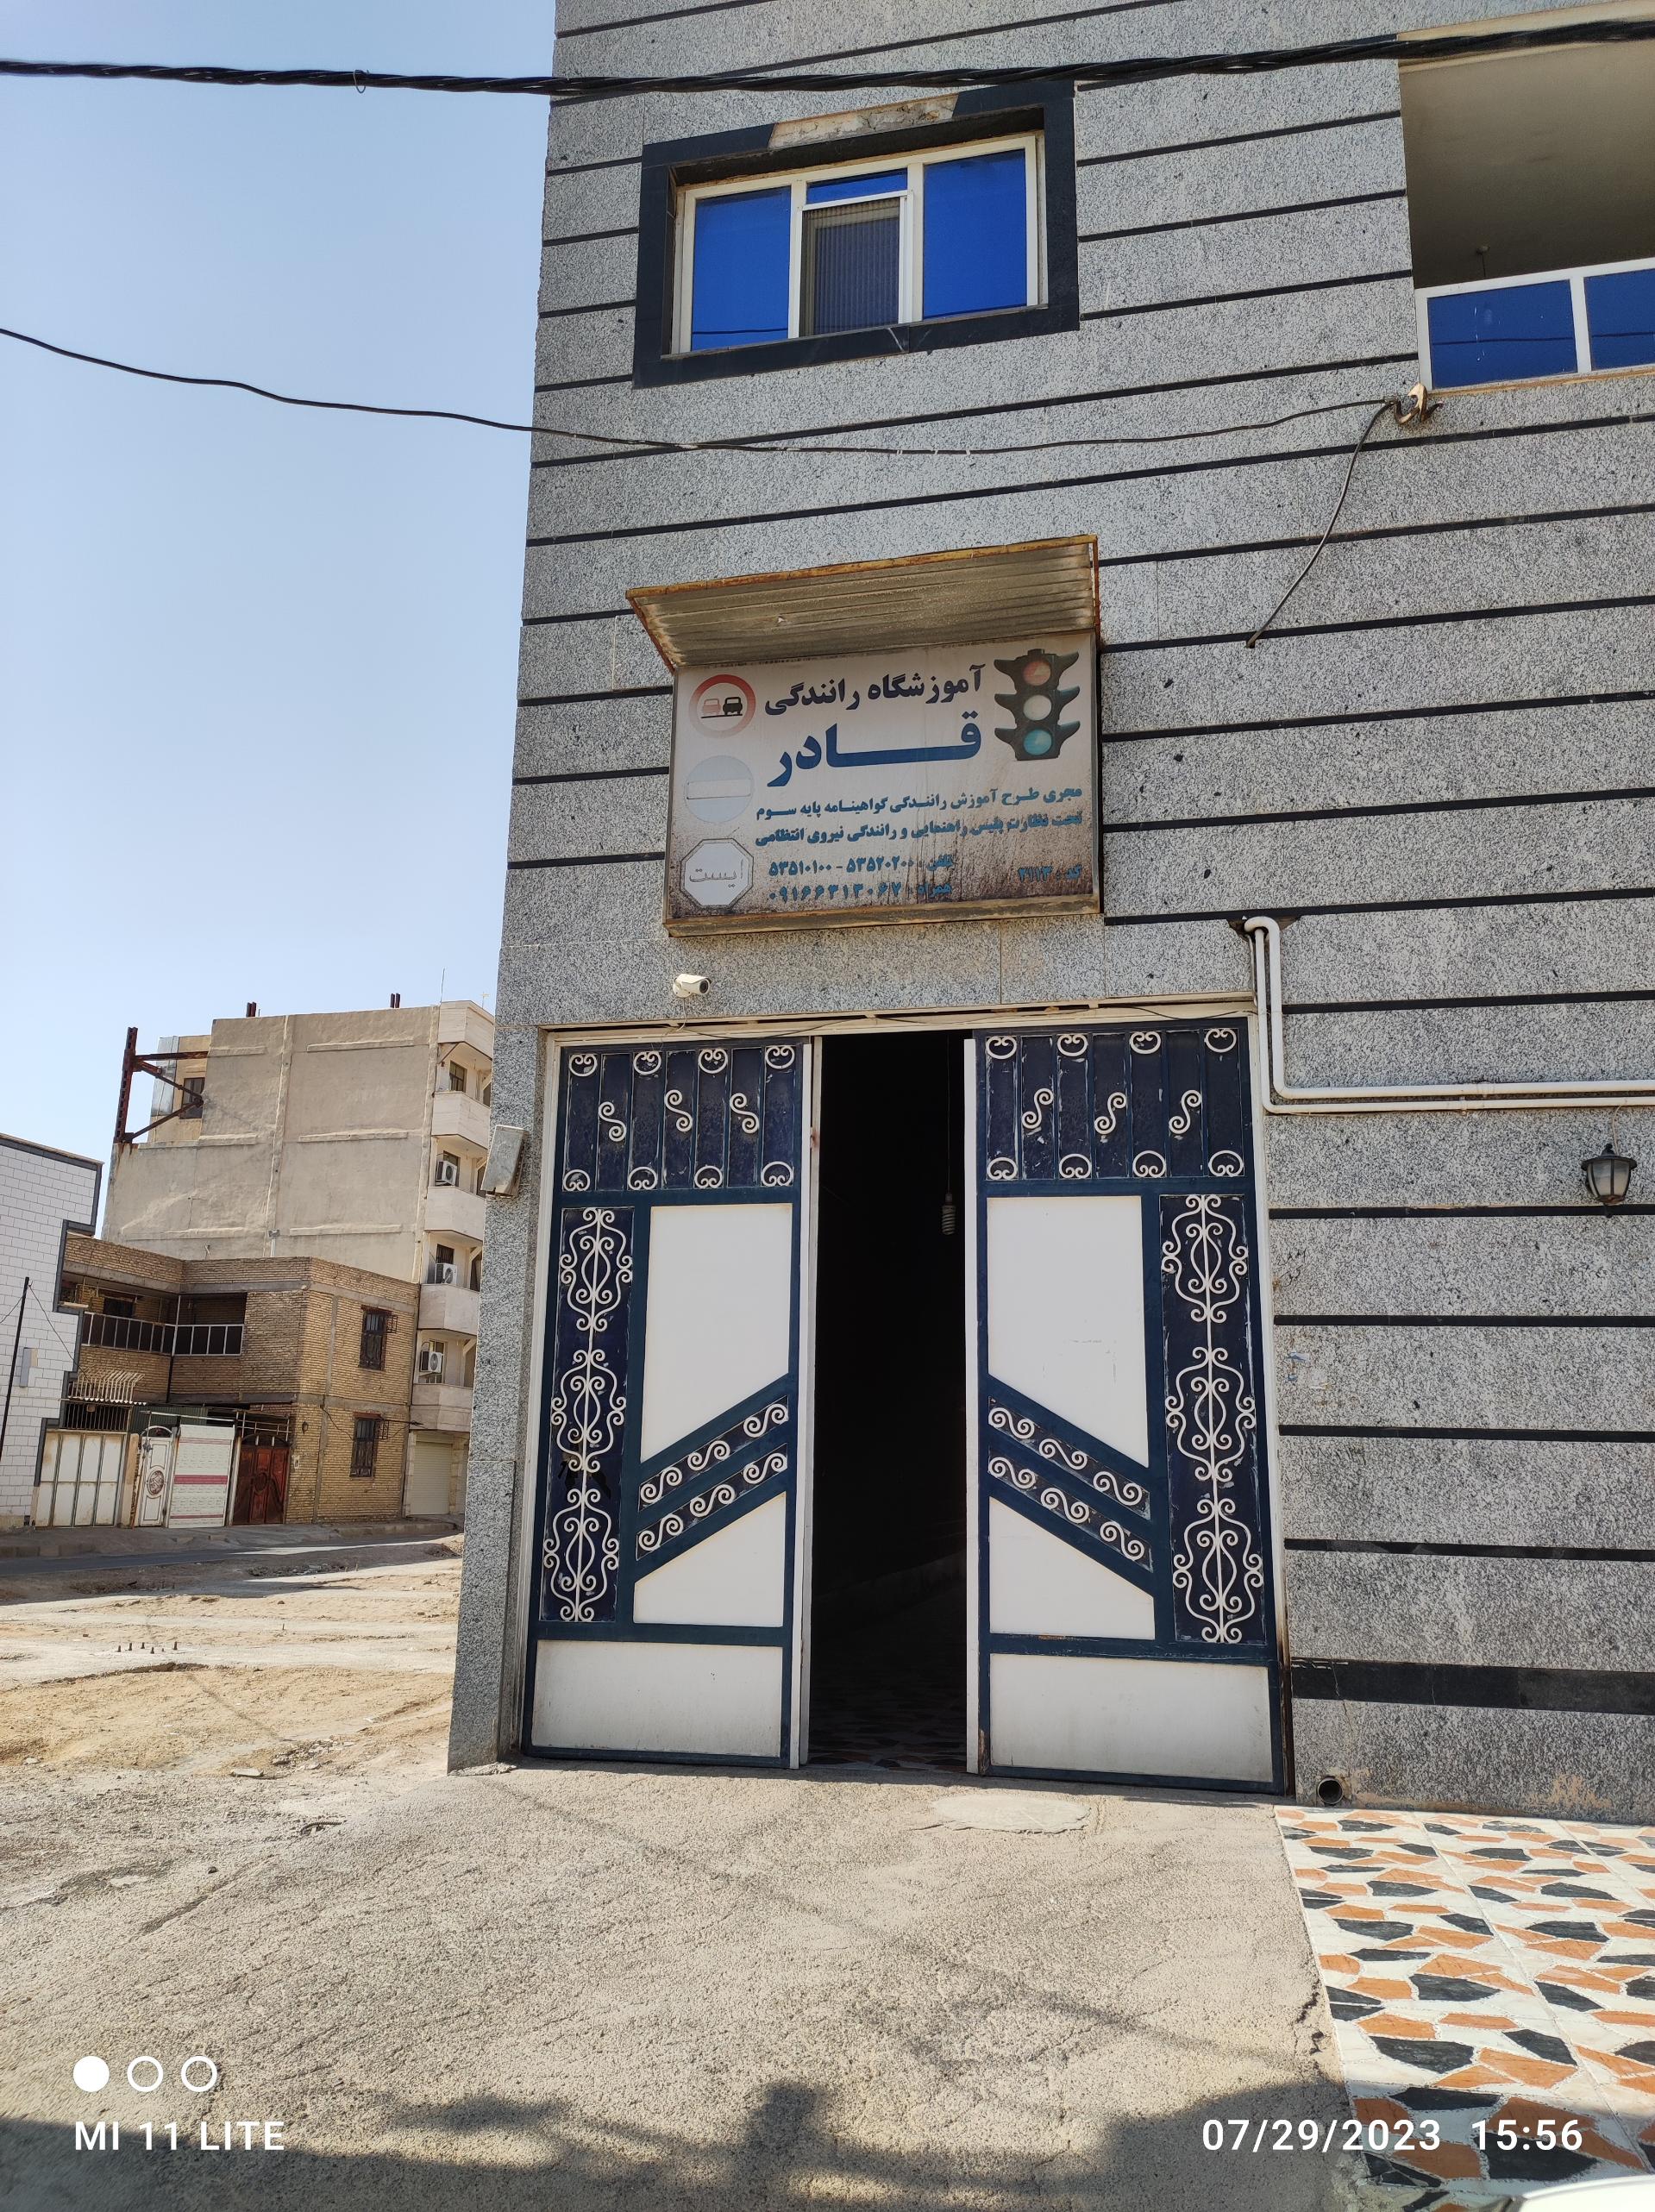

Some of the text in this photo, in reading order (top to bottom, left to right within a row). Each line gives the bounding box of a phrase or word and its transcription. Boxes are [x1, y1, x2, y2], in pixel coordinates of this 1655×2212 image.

[765, 663, 986, 716] آموزشگاه رانندگی
[767, 710, 982, 787] قادر
[756, 786, 1082, 820] مجری طرح آموزش رانندگی گواهینامه پایه سوم
[755, 810, 1082, 846] تحت نظارت پلیس راهنمایی و رانندگی نیروی انتظامی
[689, 859, 743, 888] ایست
